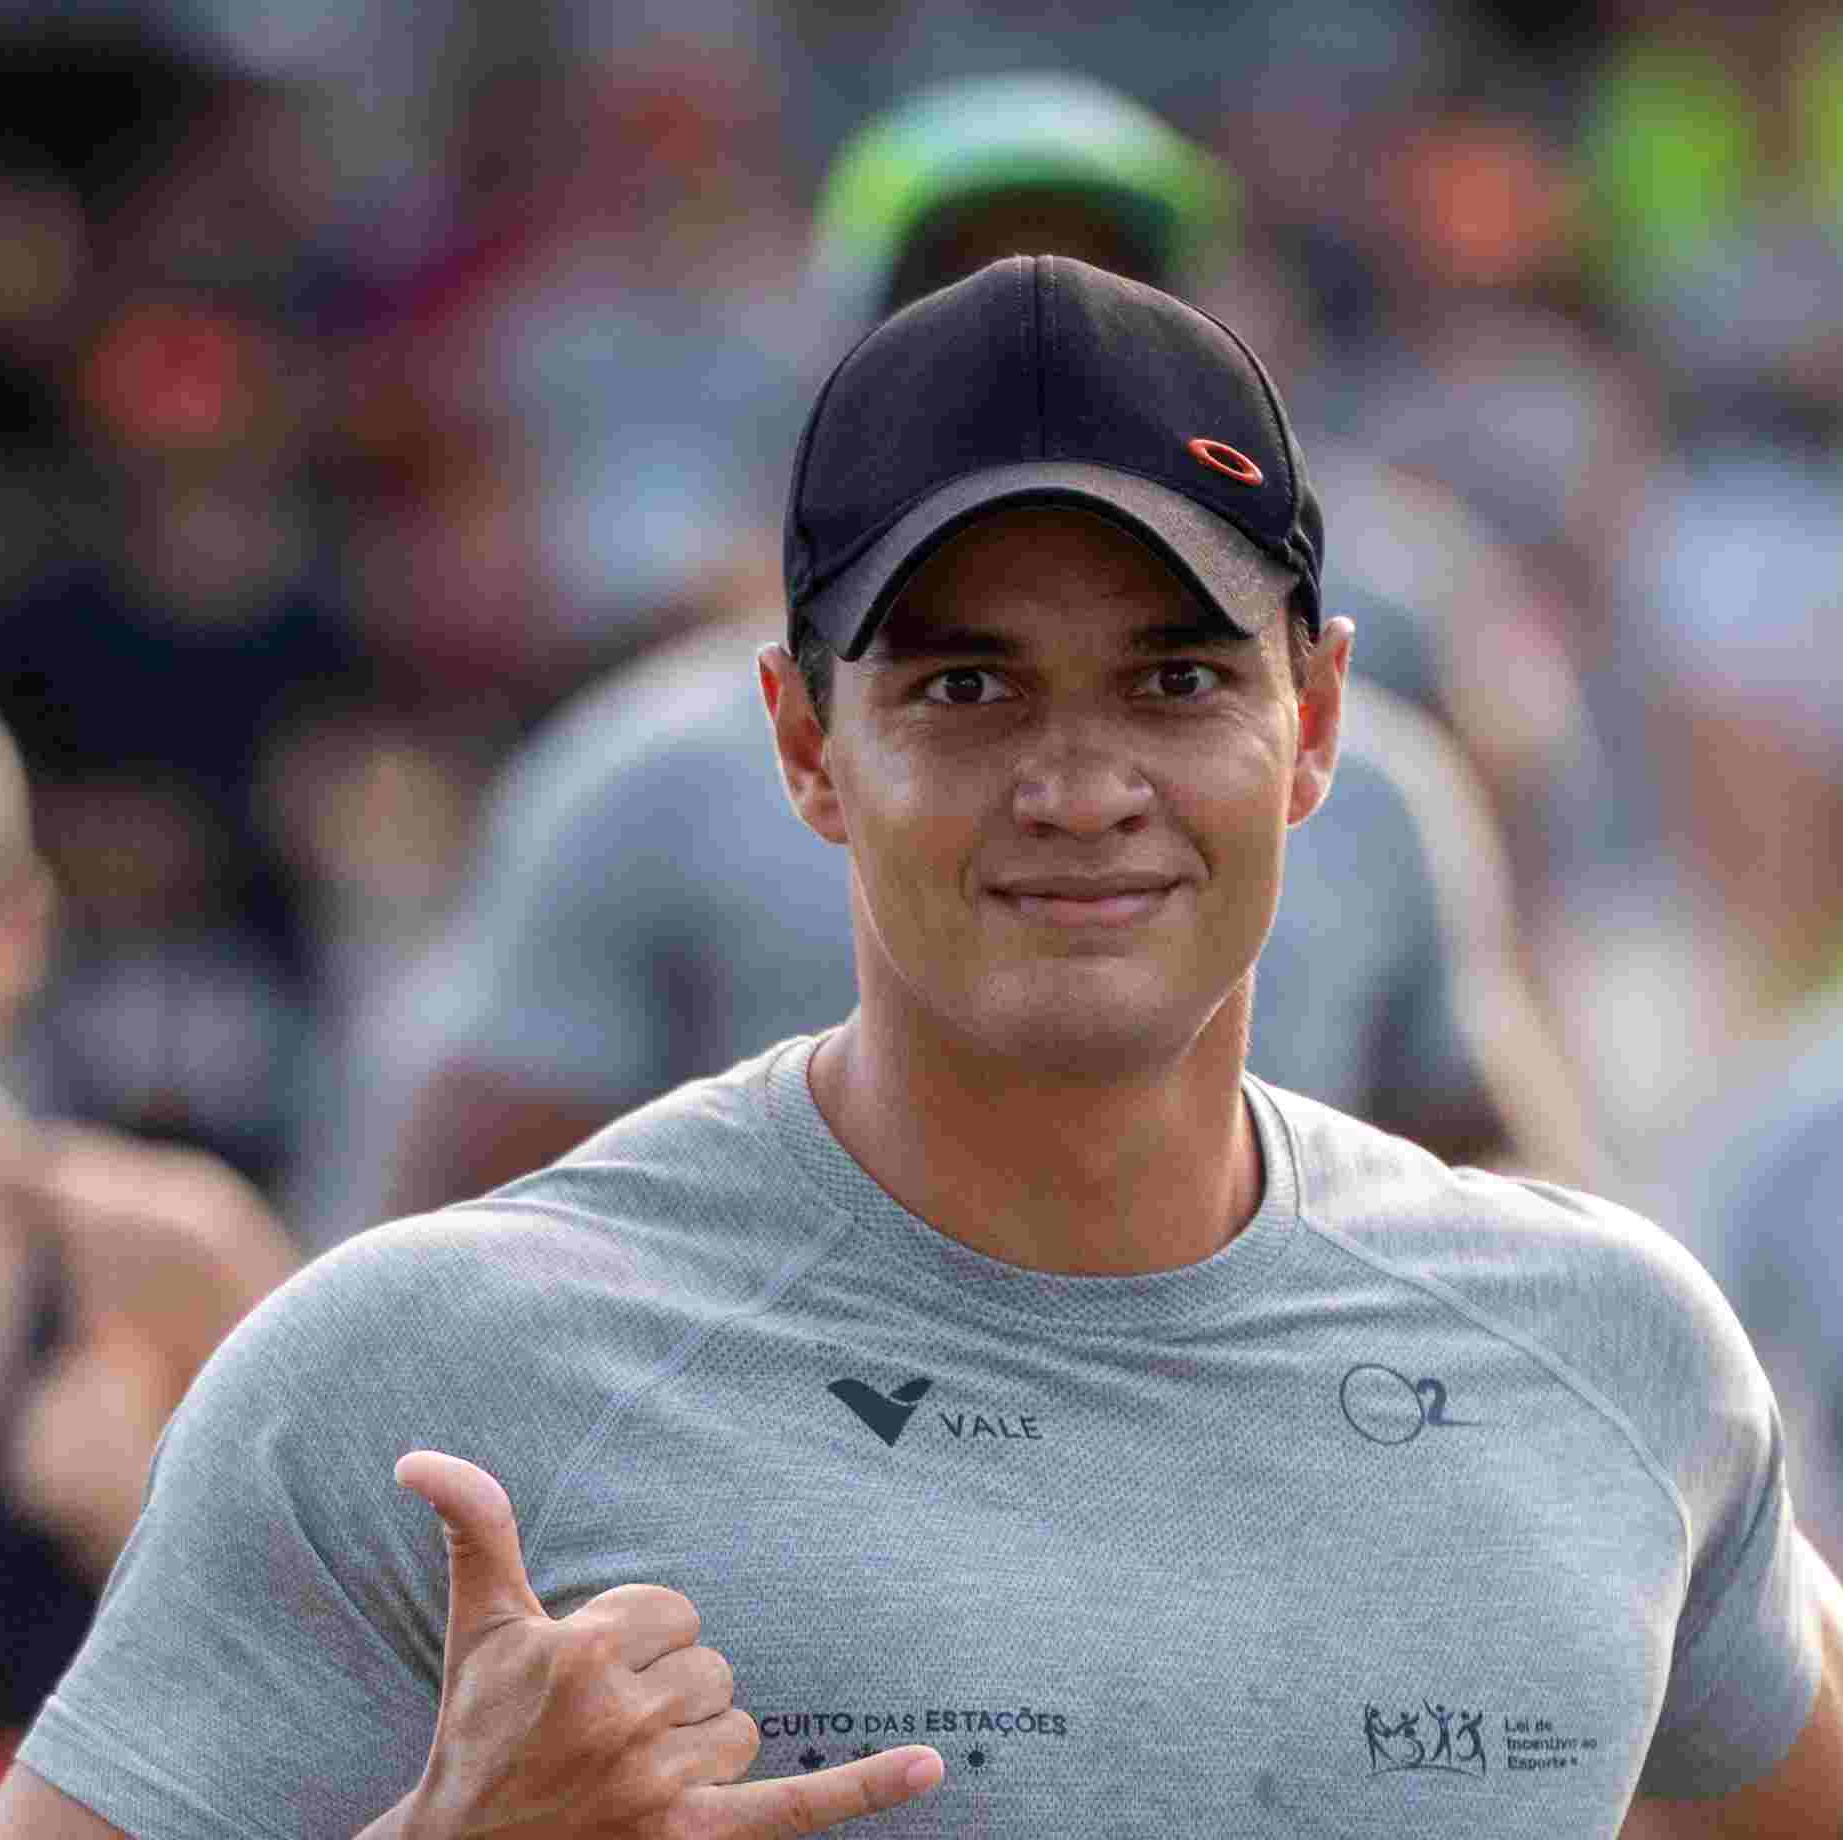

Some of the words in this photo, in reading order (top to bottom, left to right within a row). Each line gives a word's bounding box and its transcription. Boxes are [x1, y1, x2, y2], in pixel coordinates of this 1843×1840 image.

[940, 1412, 1043, 1440] VALE
[760, 1712, 855, 1739] CUITO
[864, 1713, 916, 1735] DAS
[924, 1707, 1068, 1737] ESTAÇÕES
